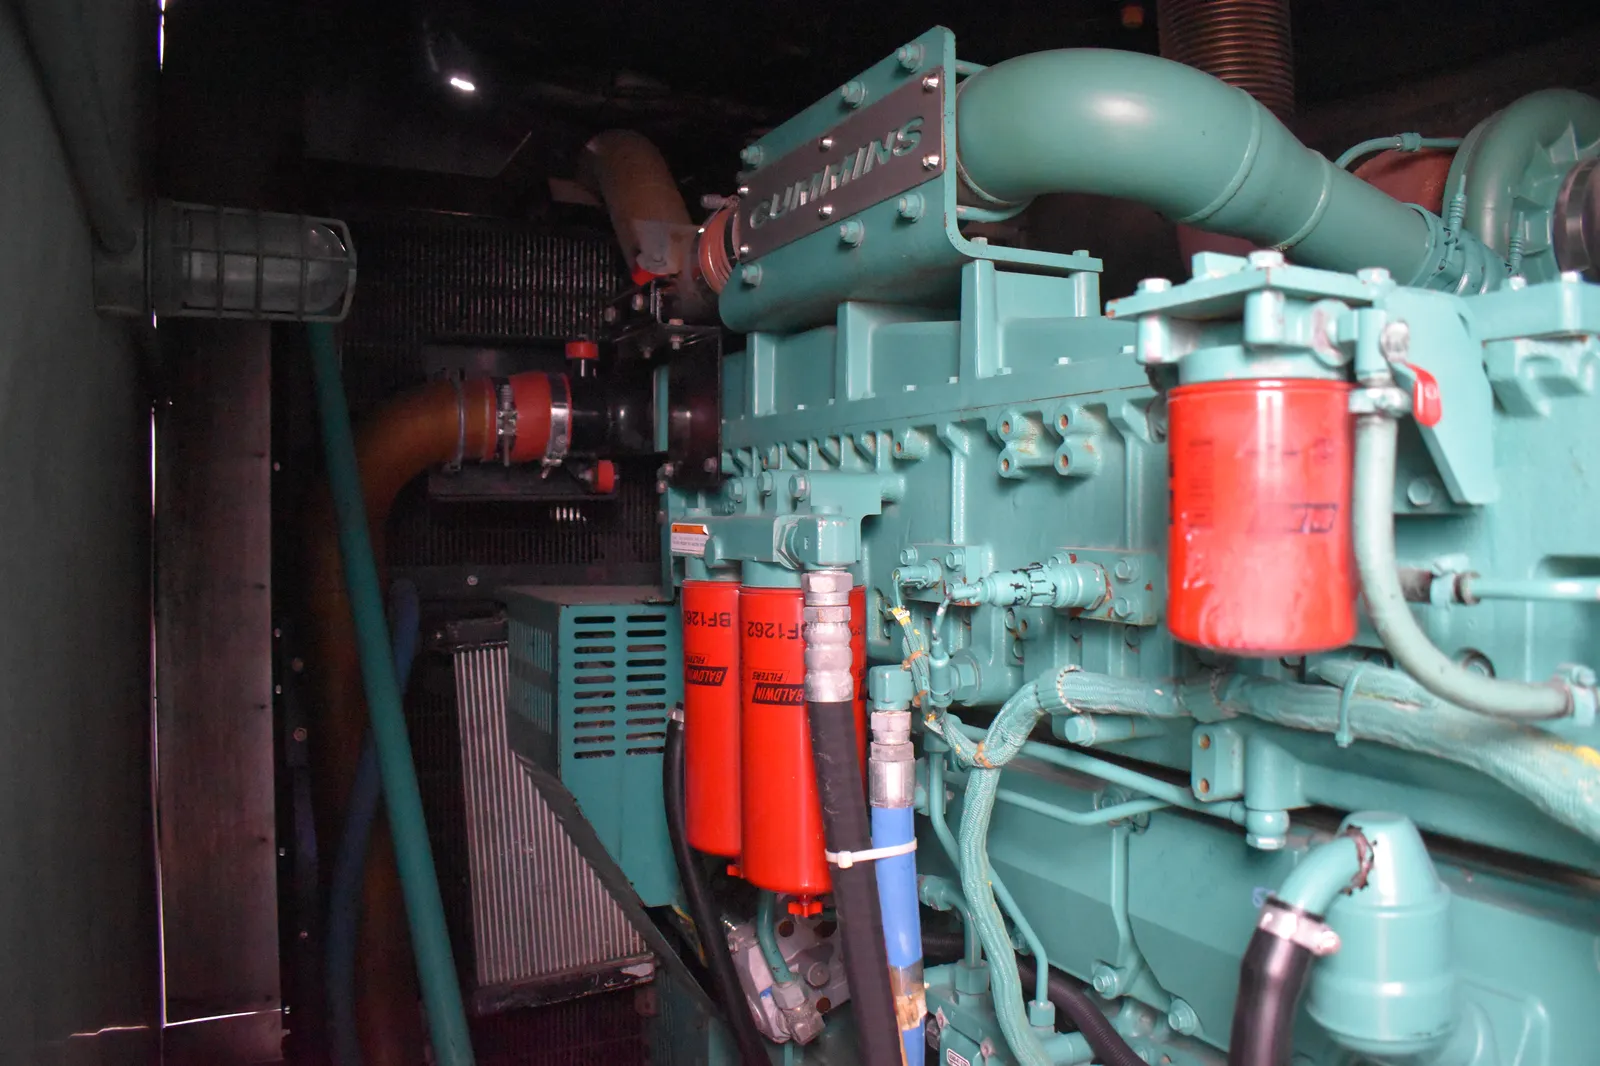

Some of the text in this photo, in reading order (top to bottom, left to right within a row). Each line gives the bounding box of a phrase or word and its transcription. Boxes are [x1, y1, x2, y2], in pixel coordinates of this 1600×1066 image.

[750, 117, 924, 229] CUMMINS
[747, 621, 807, 640] F1262
[751, 671, 784, 682] FILTERS
[755, 686, 805, 702] BALDWIN
